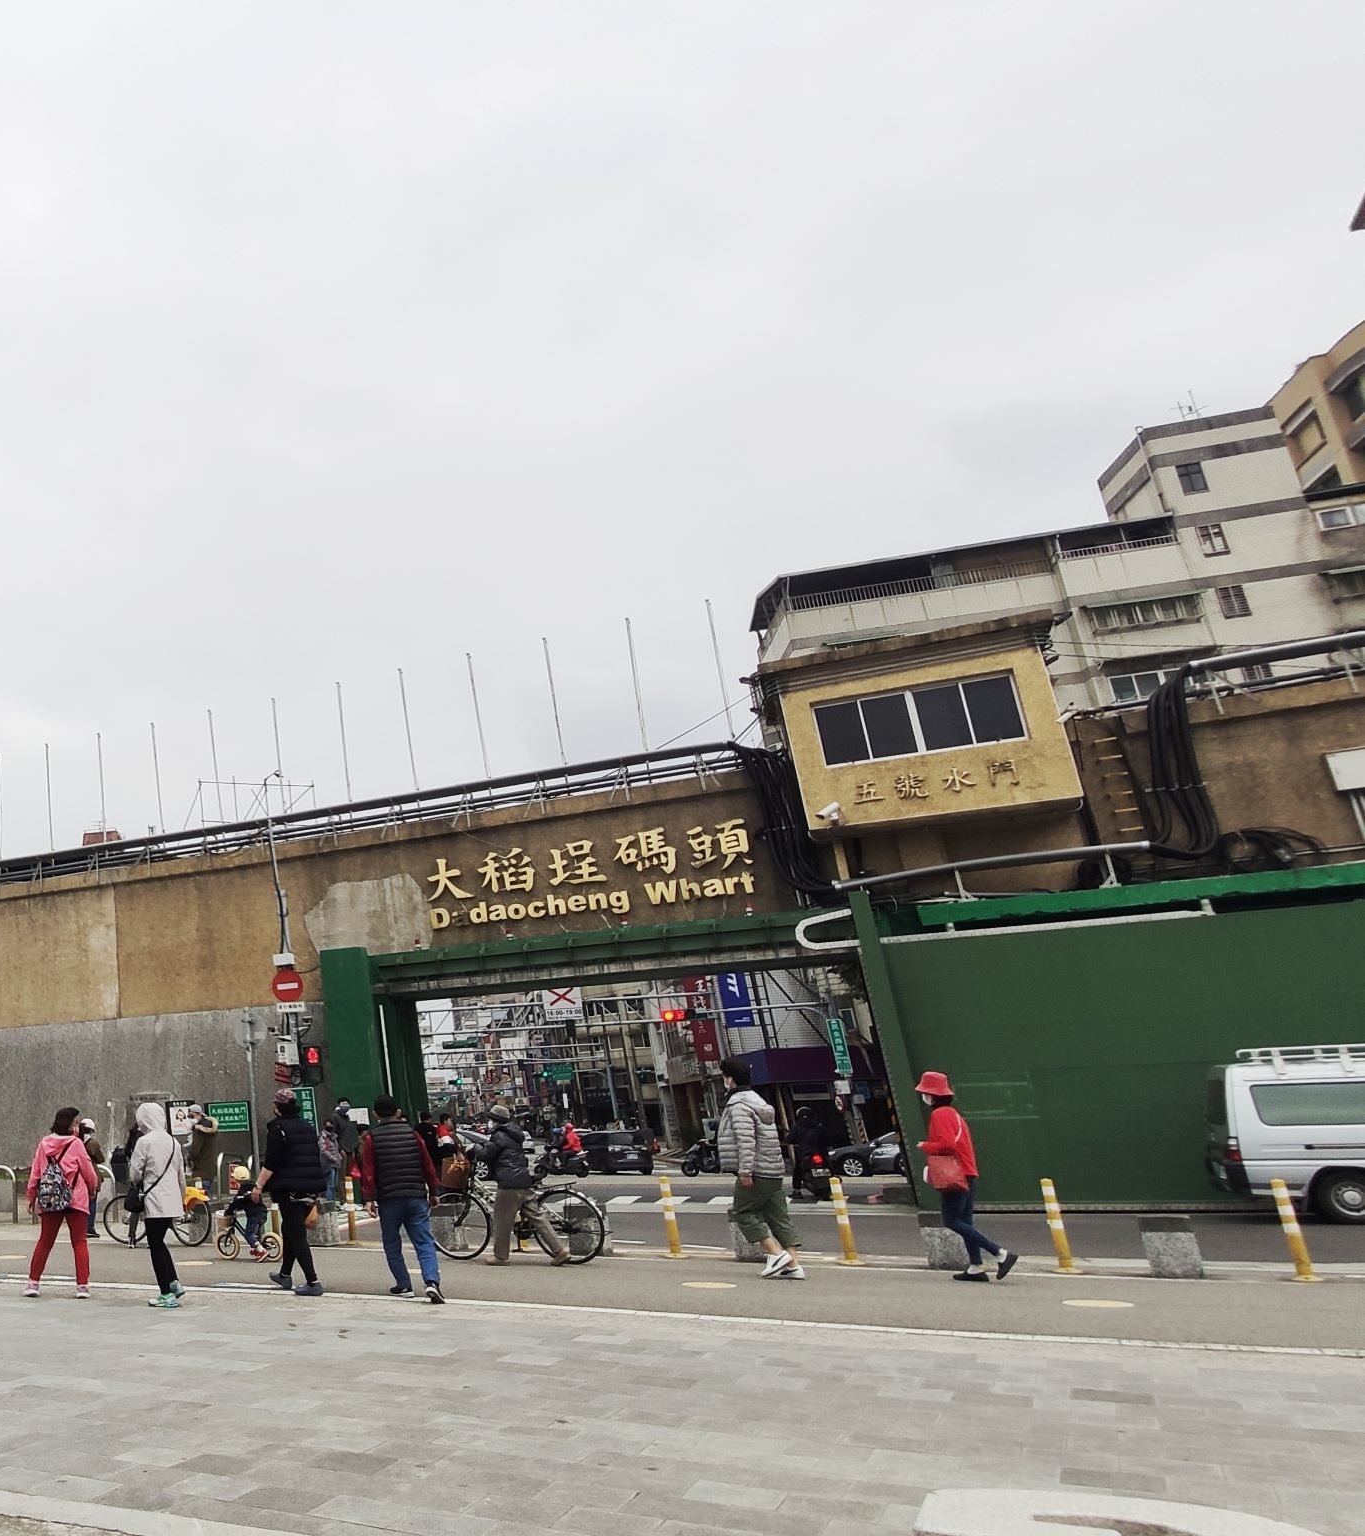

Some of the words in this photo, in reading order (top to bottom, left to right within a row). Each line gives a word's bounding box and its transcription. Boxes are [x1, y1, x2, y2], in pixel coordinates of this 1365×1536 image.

[854, 759, 1020, 804] 五號水門
[427, 818, 754, 900] 大稻埕碼頭
